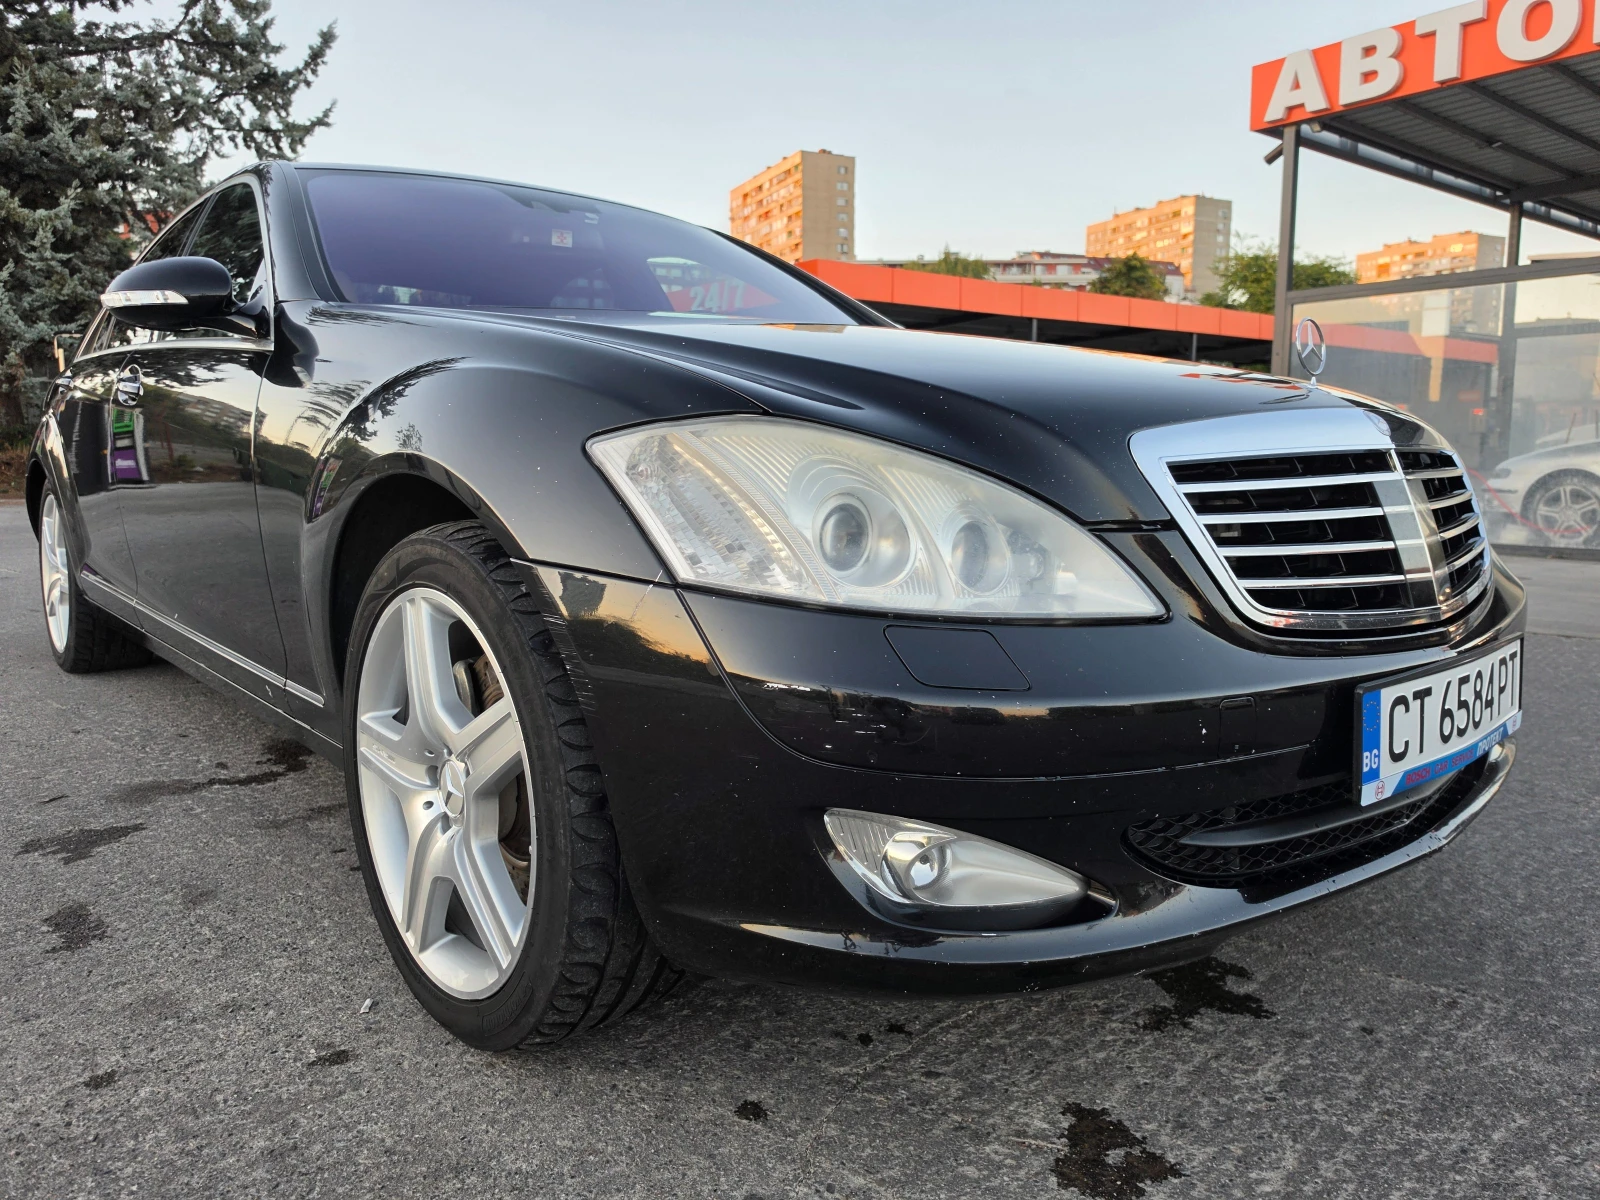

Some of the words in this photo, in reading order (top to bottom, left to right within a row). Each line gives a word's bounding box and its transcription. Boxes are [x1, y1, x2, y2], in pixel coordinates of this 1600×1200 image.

[1263, 0, 1600, 123] АВТО
[689, 279, 746, 312] 24/7
[1388, 686, 1433, 763] CT
[1439, 661, 1494, 744] 6584
[1498, 650, 1518, 717] PT
[1362, 749, 1379, 773] BG
[1405, 766, 1431, 785] BOSCH
[1434, 760, 1449, 775] CAR
[1451, 748, 1475, 768] SERVICE
